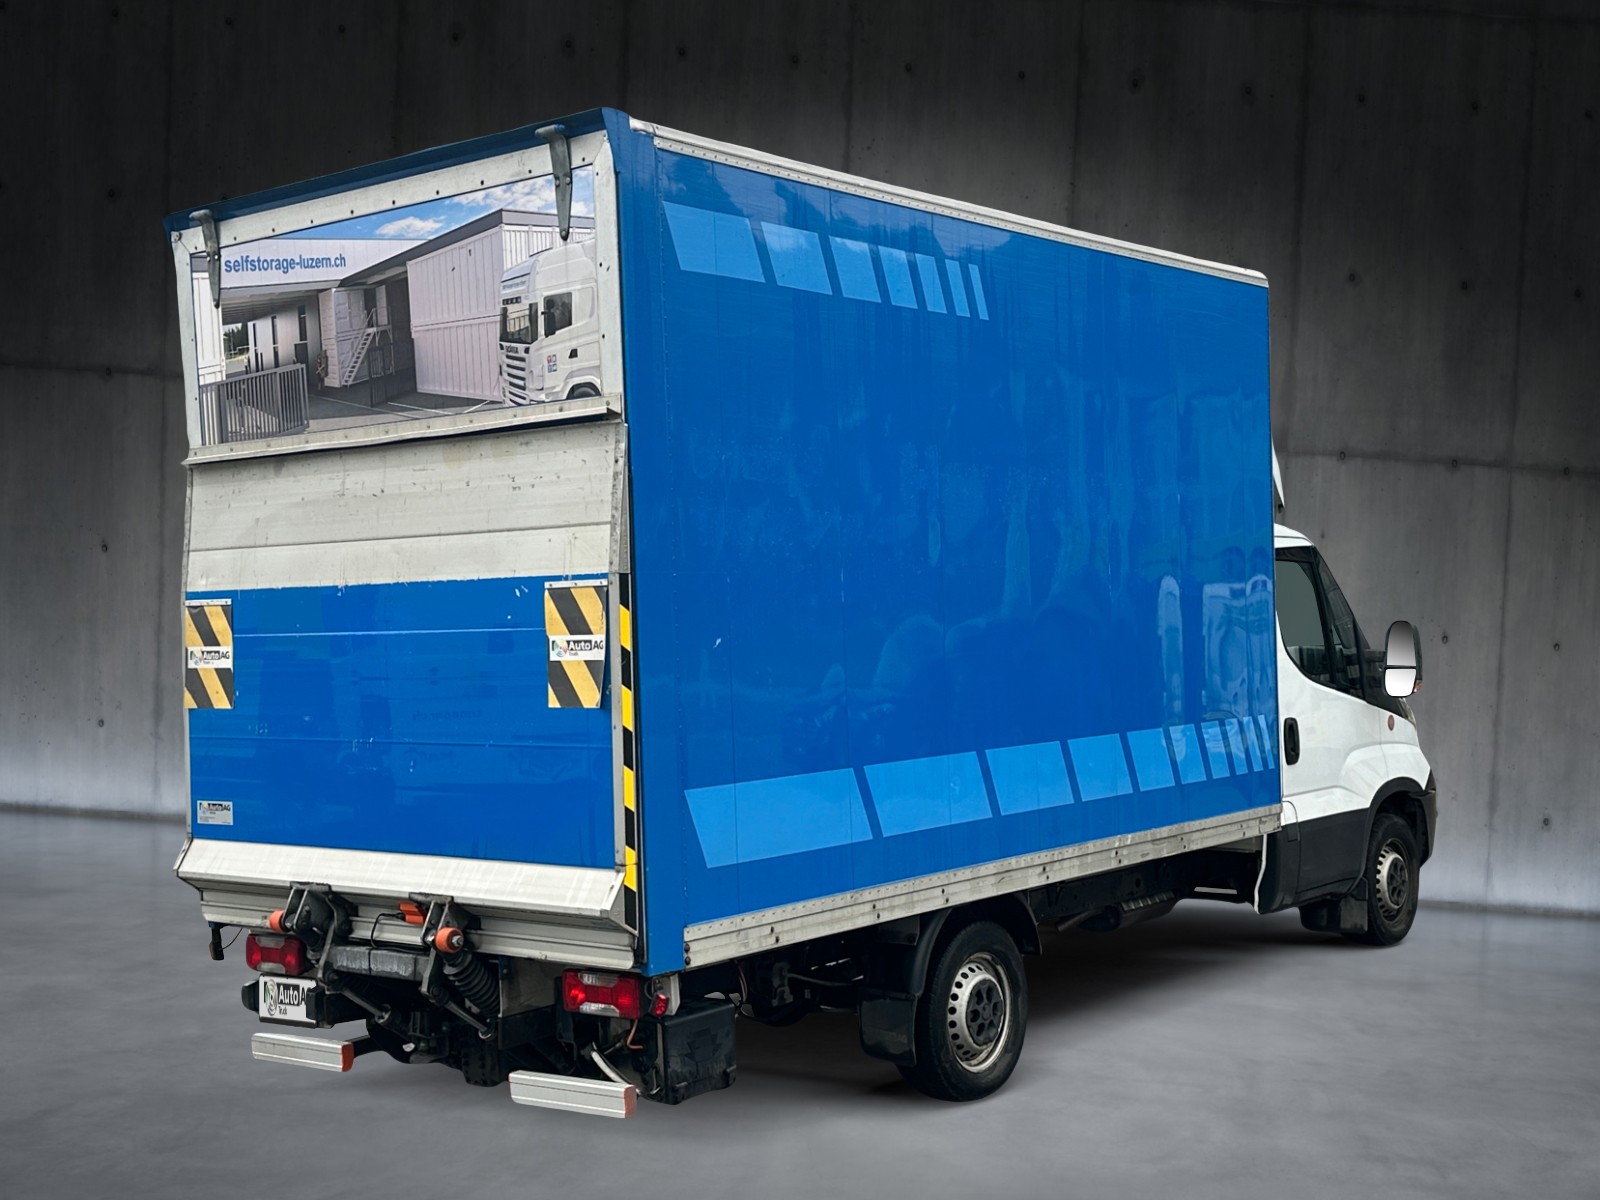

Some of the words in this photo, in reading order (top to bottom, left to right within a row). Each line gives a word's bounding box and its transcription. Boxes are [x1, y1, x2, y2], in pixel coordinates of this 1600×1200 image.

[569, 641, 591, 650] Auto
[593, 641, 603, 649] AG
[221, 651, 230, 659] AG
[278, 984, 299, 1005] Auto
[300, 986, 307, 1006] A
[278, 1006, 288, 1016] Truck
